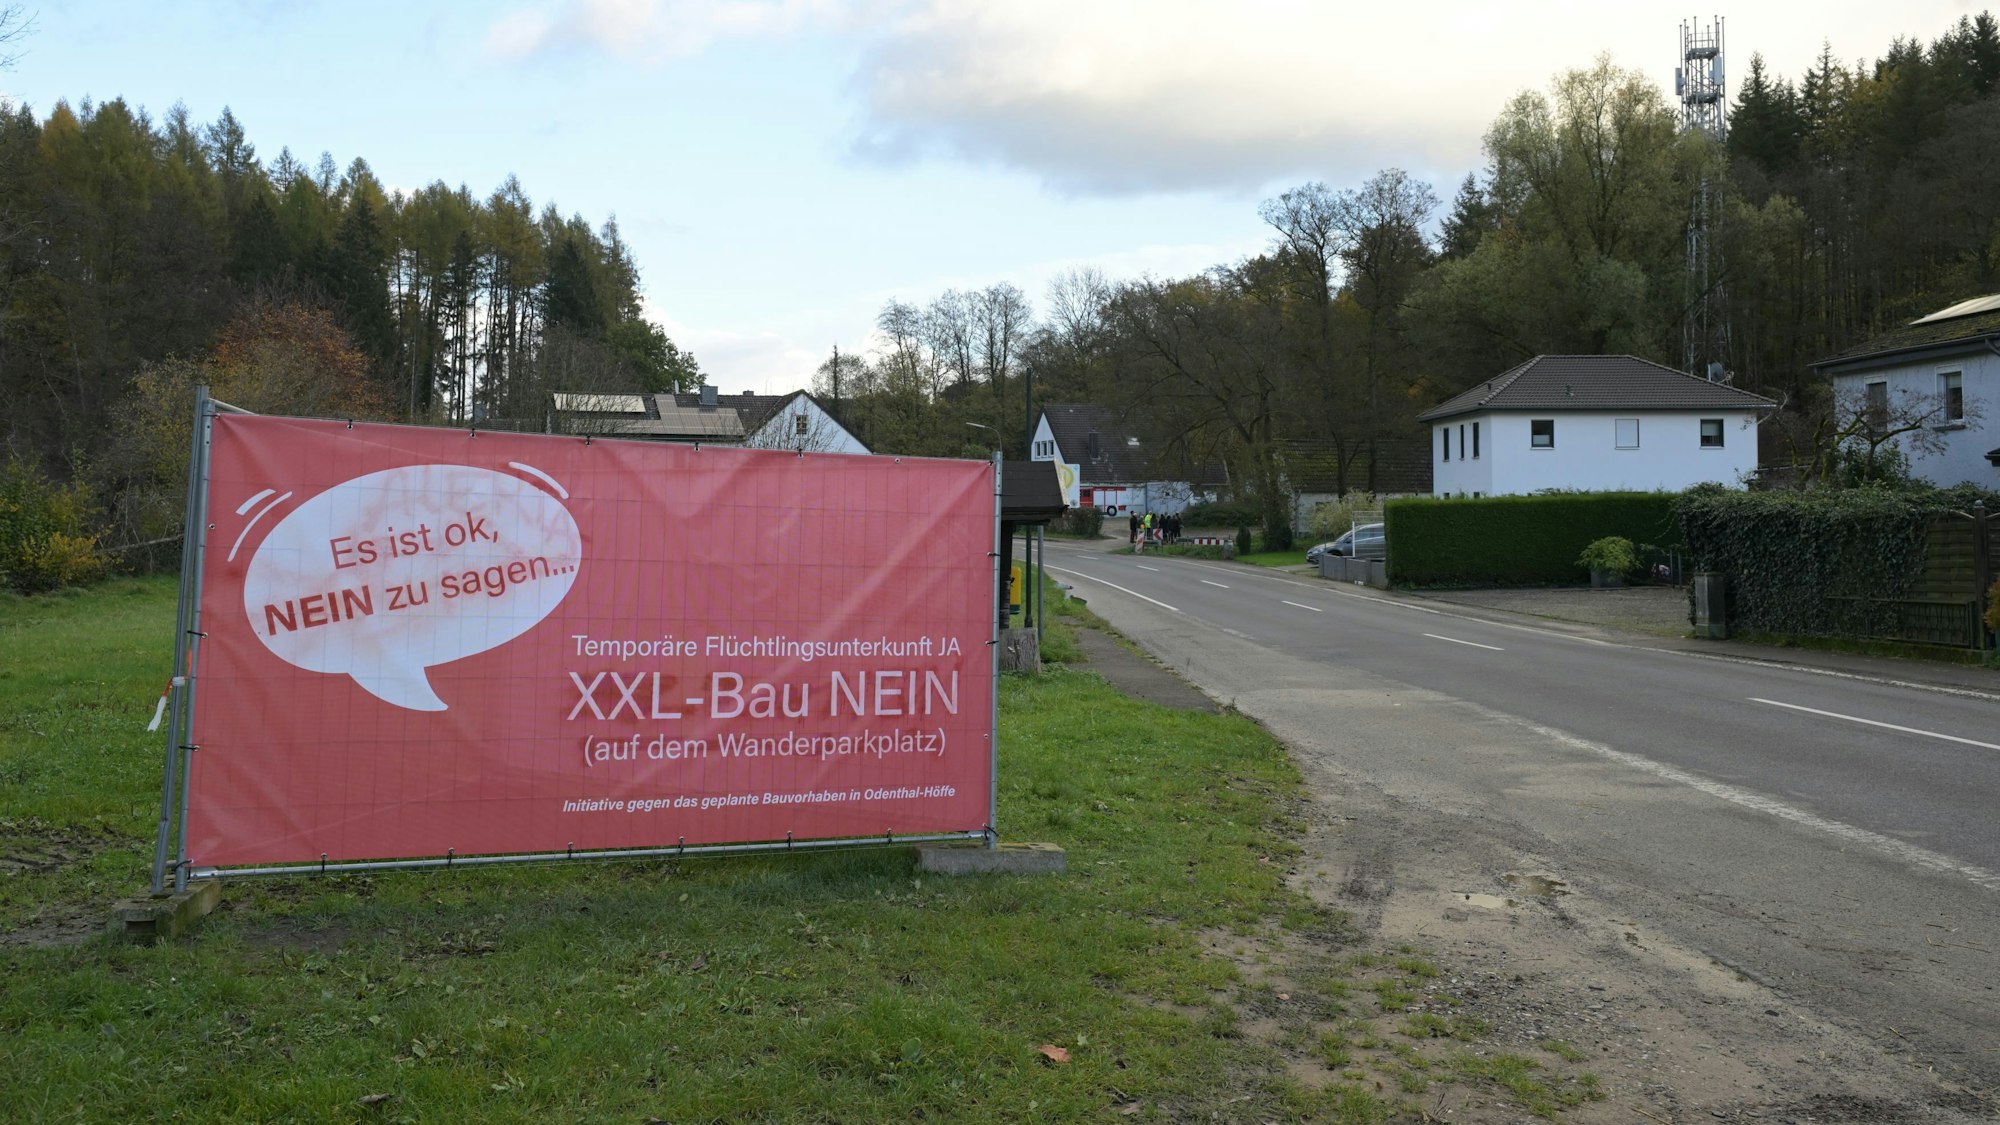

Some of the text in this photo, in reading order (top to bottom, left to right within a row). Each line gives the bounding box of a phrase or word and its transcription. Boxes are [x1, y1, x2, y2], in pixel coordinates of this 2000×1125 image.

[330, 512, 499, 570] Es ist ok,
[264, 556, 575, 637] NEIN zu sagen...
[571, 635, 961, 662] Temporäre Flüchtlingsunterkunft JA
[566, 670, 959, 721] XXL-Bau NEIN
[583, 727, 947, 767] (auf dem Wanderparkplatz)
[562, 785, 956, 813] Initiative gegen das geplante Bauvorhaben in Odenthal-Höffe
